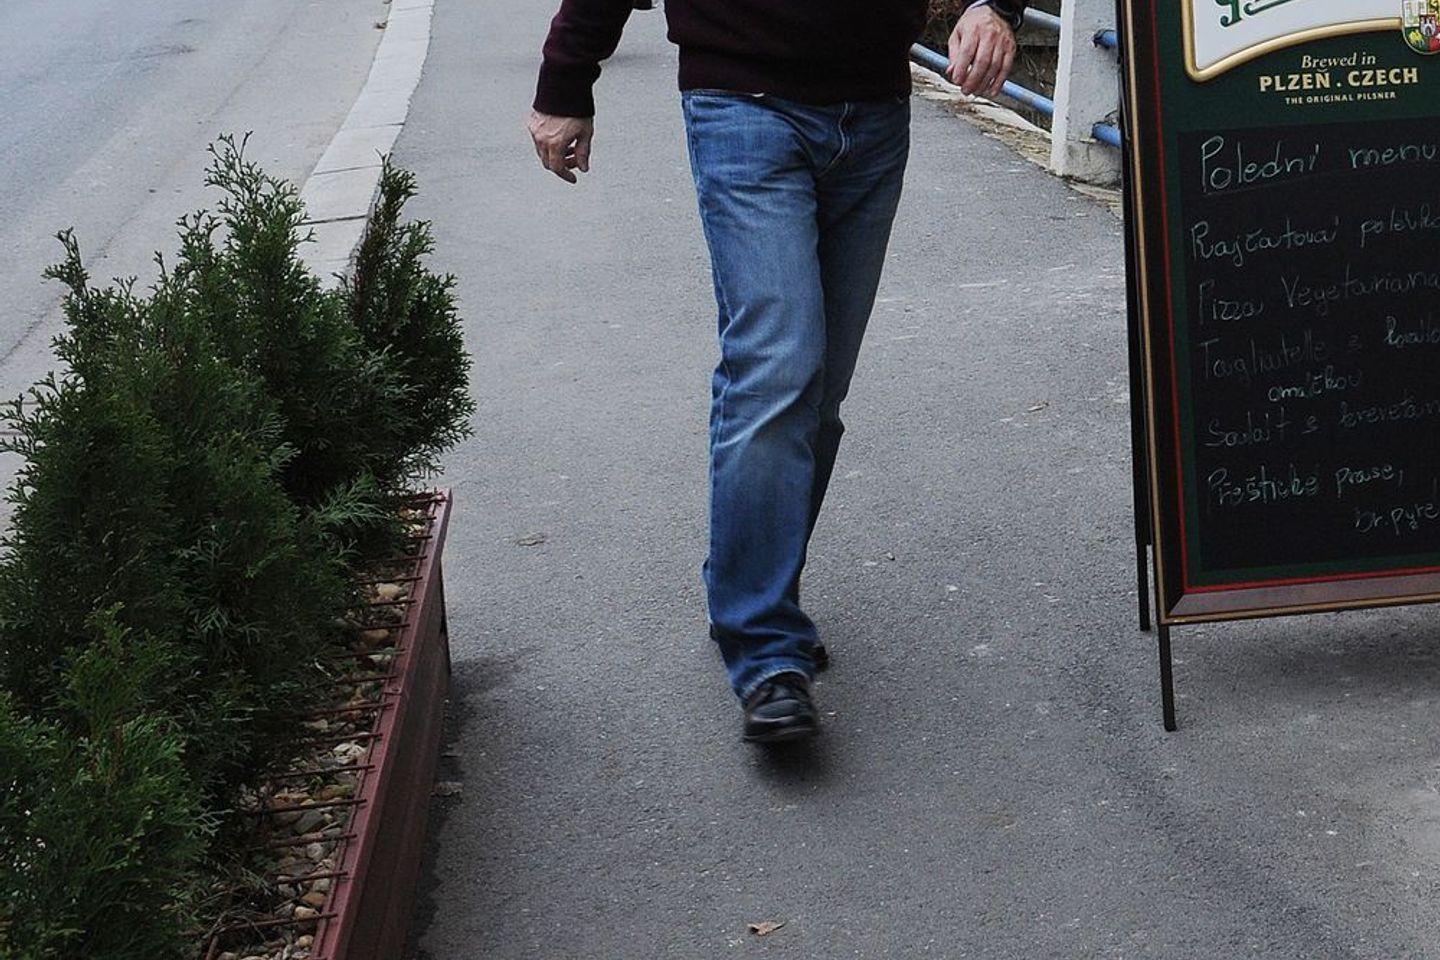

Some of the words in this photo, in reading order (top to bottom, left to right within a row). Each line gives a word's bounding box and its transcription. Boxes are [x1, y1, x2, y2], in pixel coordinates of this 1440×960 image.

[1301, 52, 1357, 69] Brewed
[1361, 52, 1376, 66] in
[1259, 68, 1331, 92] PLZEŇ
[1348, 67, 1418, 87] CZECH
[1285, 96, 1303, 105] THE
[1306, 94, 1353, 104] ORIGINAL
[1357, 91, 1396, 101] PILSNER
[1349, 143, 1437, 170] menu
